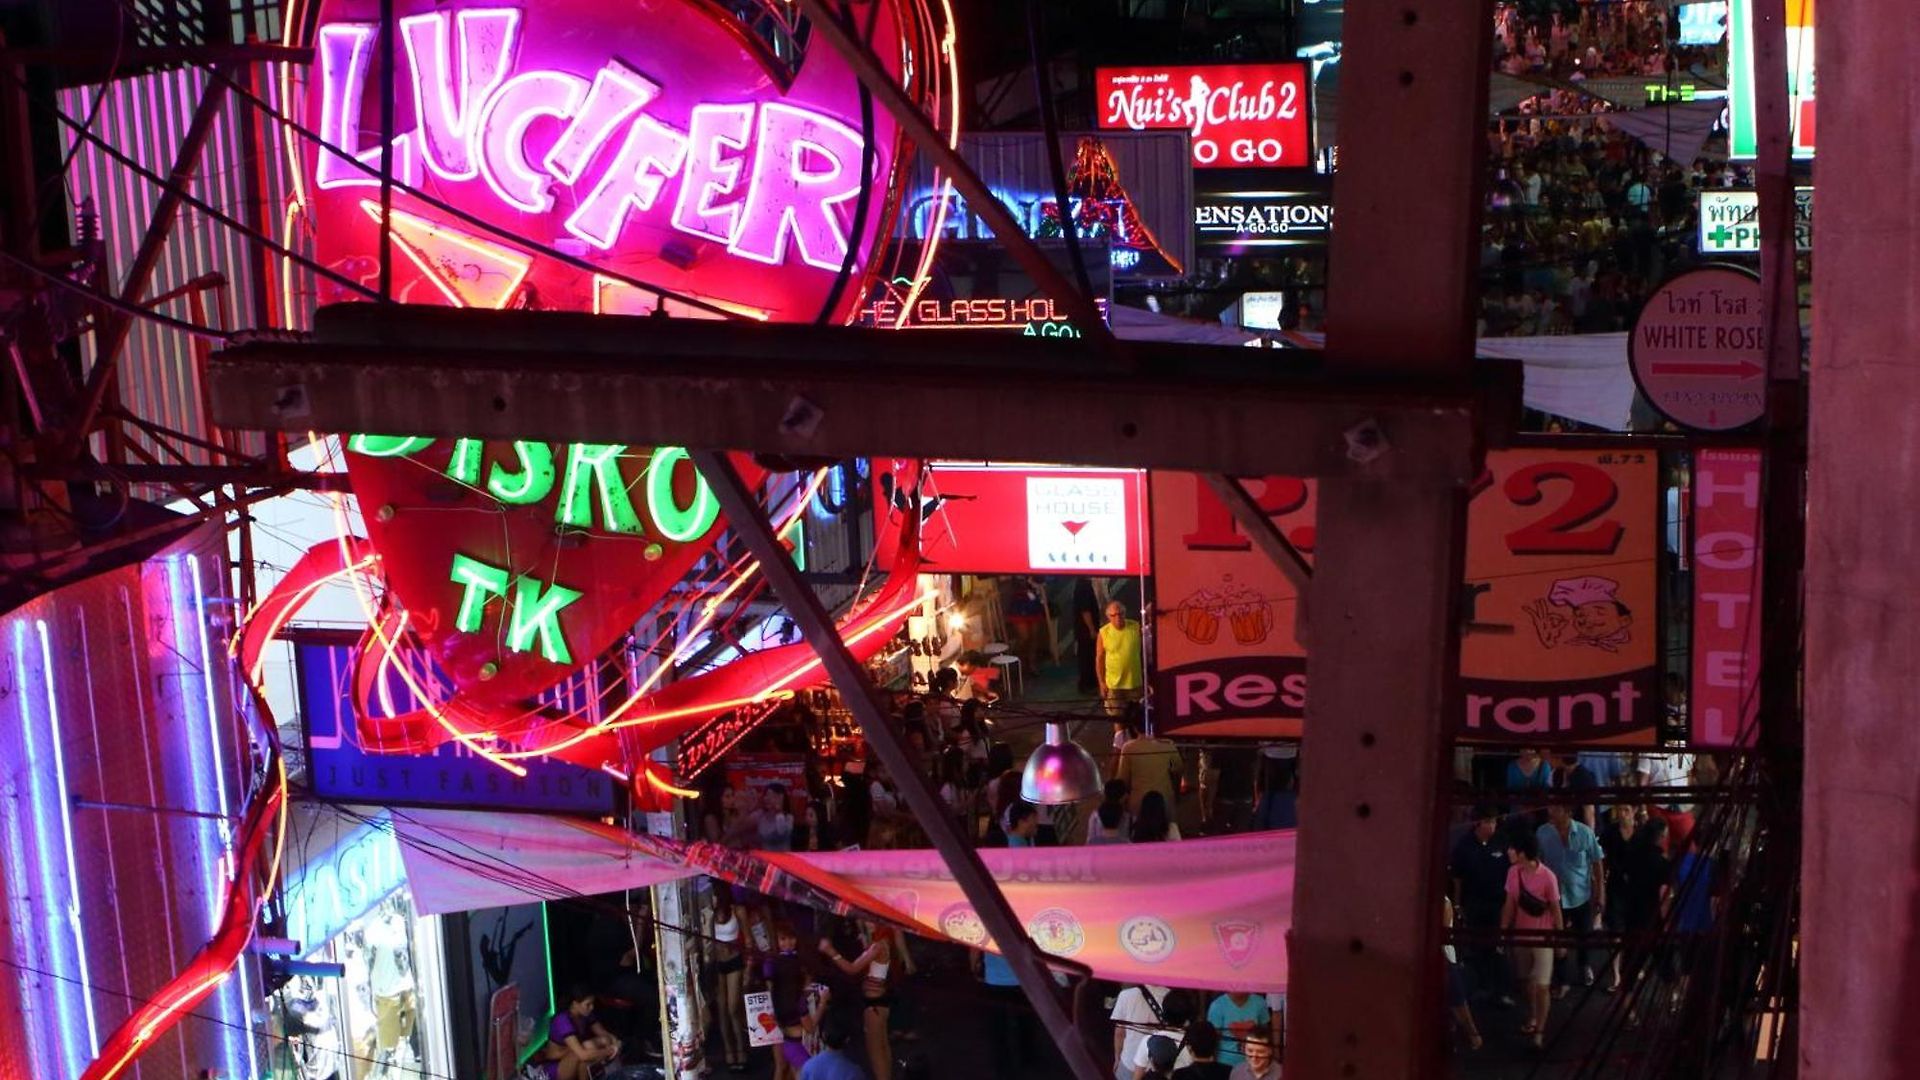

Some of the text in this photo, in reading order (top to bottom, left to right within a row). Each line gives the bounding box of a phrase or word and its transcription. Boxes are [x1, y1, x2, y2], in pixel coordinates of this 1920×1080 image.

[1107, 82, 1298, 130] Nui's Club 2
[316, 6, 864, 273] LUCIFER
[1230, 139, 1283, 162] GO
[918, 300, 1006, 321] GLASS
[1643, 326, 1708, 349] WHITE
[1035, 500, 1119, 515] HOUSE
[450, 553, 584, 664] TK
[1697, 470, 1761, 745] HOTEL
[1175, 671, 1642, 733] Resrant
[327, 766, 603, 798] JUST FASHION
